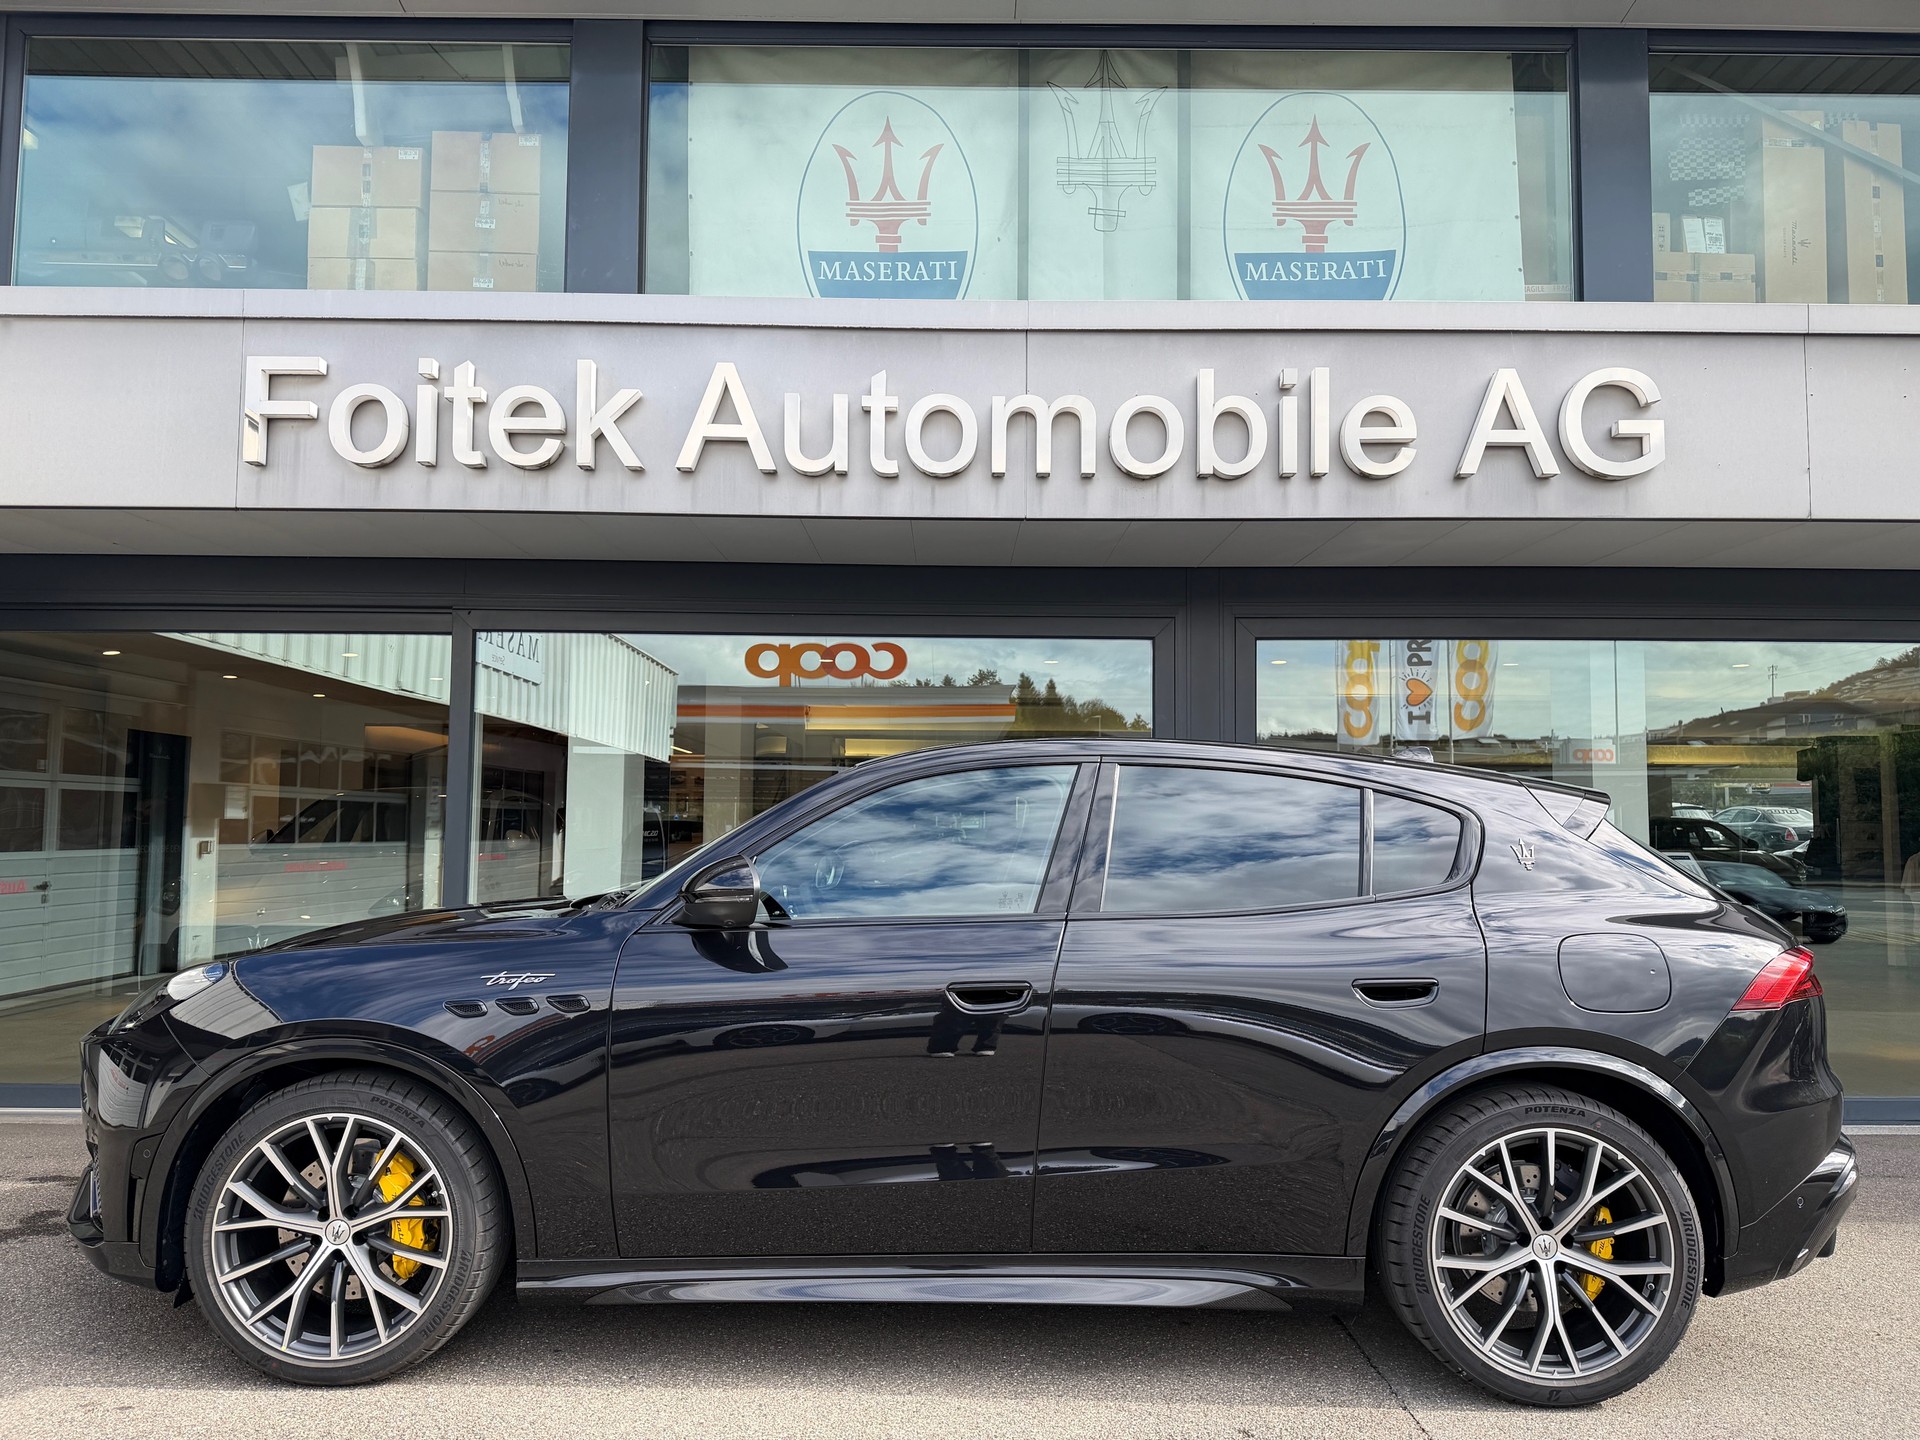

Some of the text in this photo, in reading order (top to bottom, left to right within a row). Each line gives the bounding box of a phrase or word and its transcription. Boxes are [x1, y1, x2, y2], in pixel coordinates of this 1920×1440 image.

[818, 260, 958, 282] MASERATI
[1245, 259, 1387, 282] MASERATI
[1525, 285, 1545, 293] AGILE
[242, 355, 1666, 481] Foitek Automobile AG
[1408, 711, 1431, 725] I
[480, 971, 556, 990] trofeo
[370, 1096, 425, 1128] POTENZA
[1525, 1105, 1586, 1117] POTENZA
[193, 1131, 246, 1220] BRIDGESTONE
[1415, 1194, 1431, 1295] BRIDGESTONE
[1680, 1210, 1697, 1311] BRIDGESTONE
[420, 1249, 472, 1338] BRIDGESTONE
